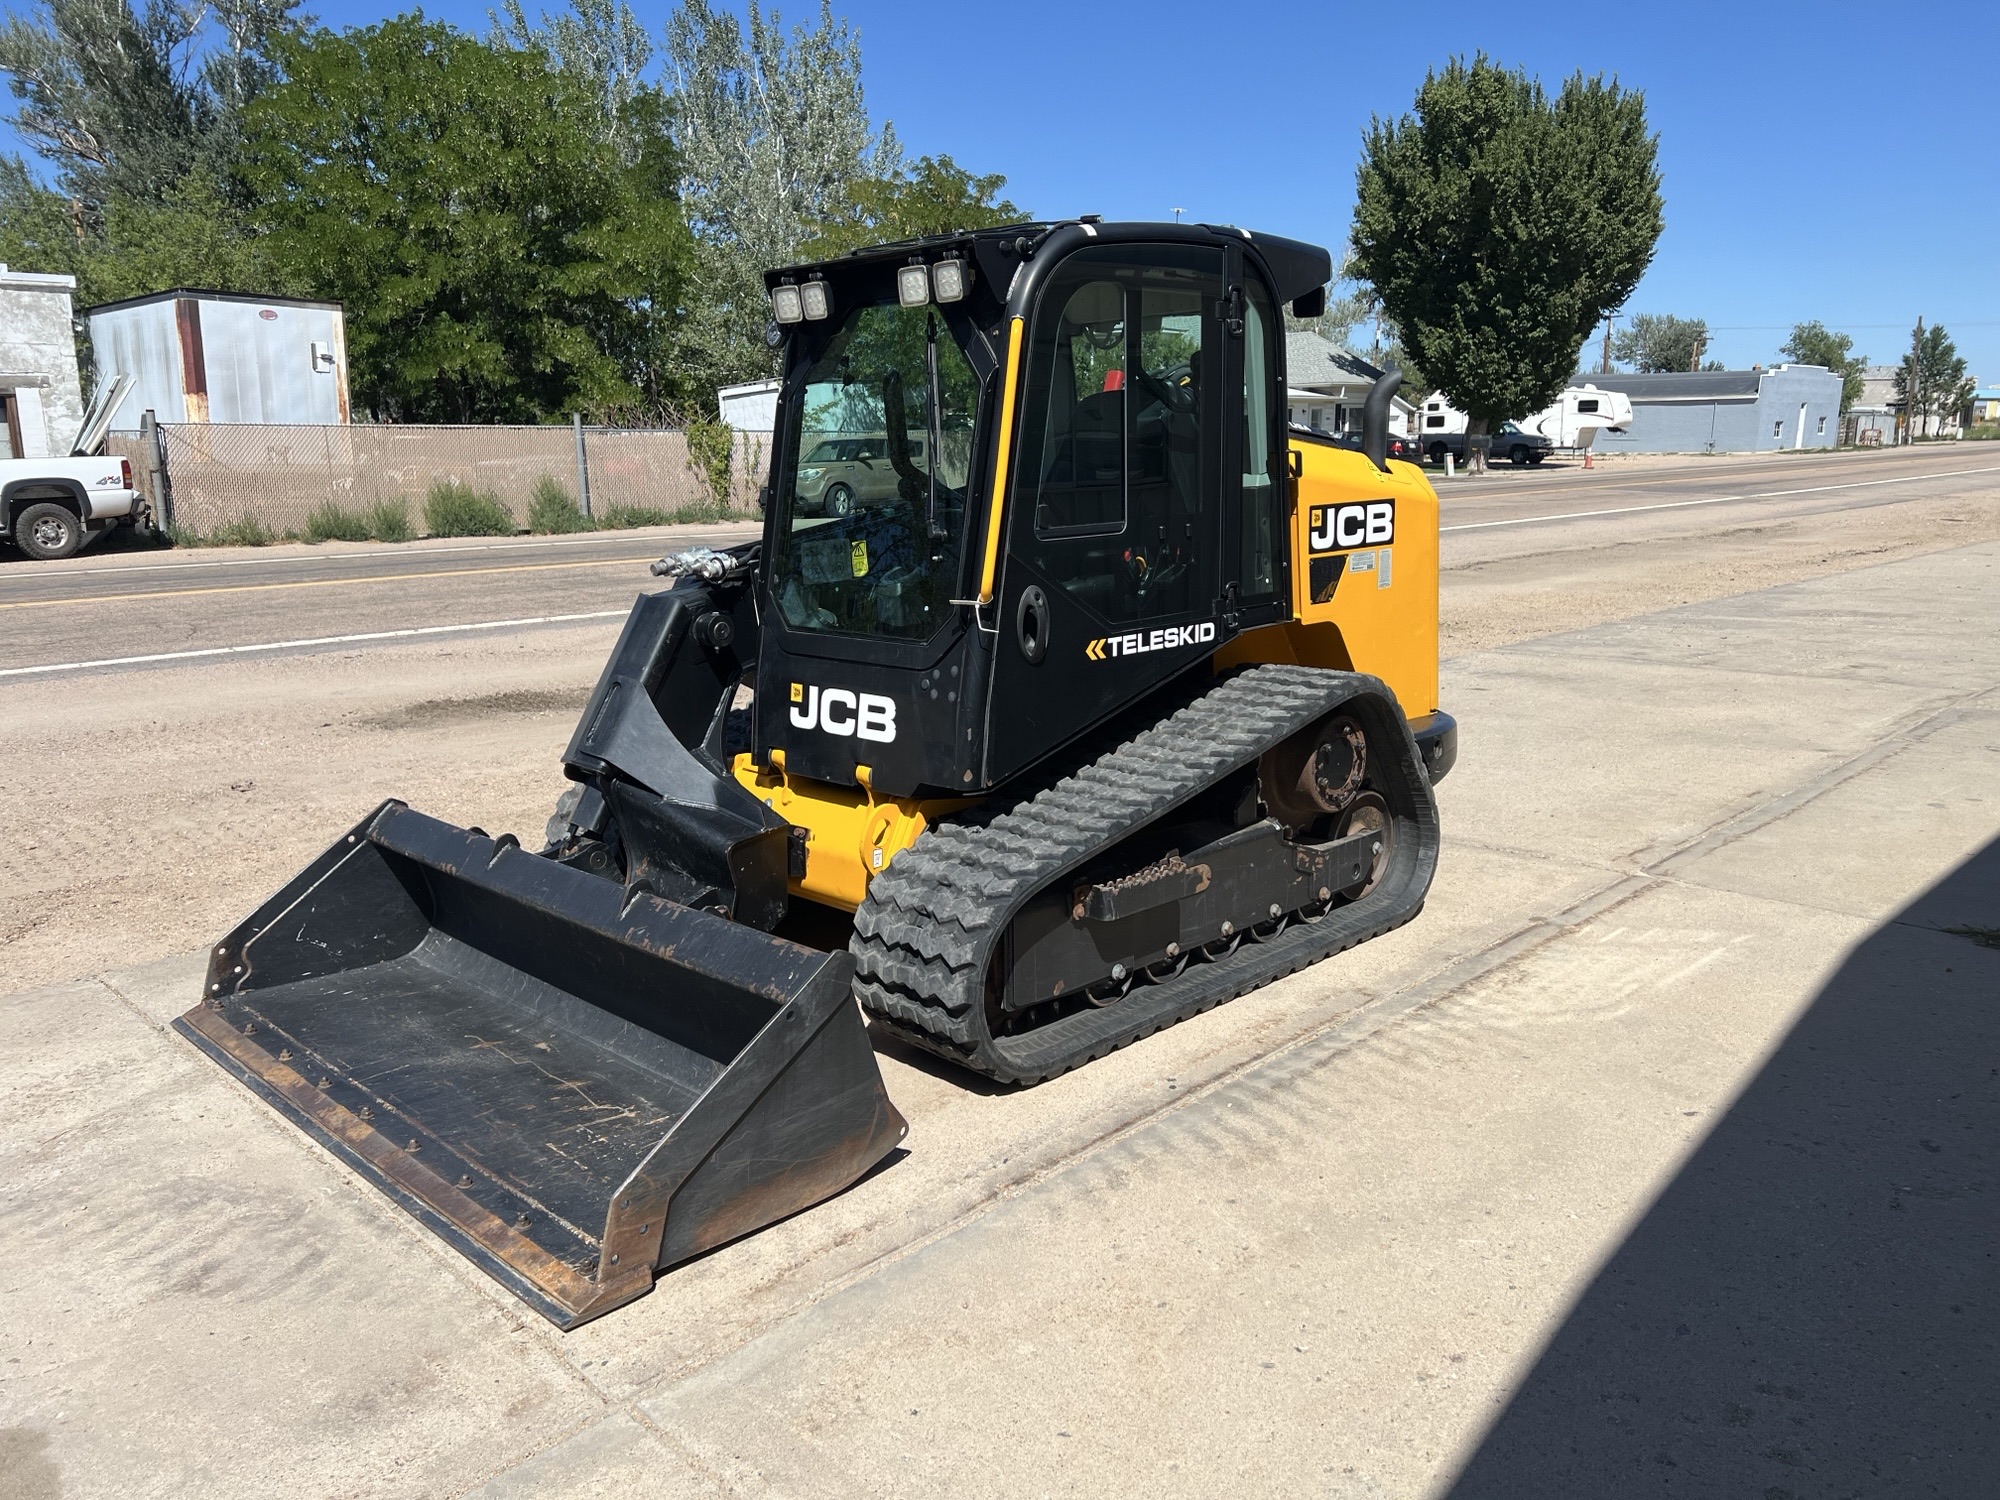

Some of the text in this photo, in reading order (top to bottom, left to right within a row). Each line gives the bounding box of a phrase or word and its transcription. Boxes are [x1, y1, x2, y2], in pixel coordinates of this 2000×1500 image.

[1311, 503, 1393, 550] JCB
[1107, 622, 1215, 657] TELESKID
[790, 684, 897, 744] JCB
